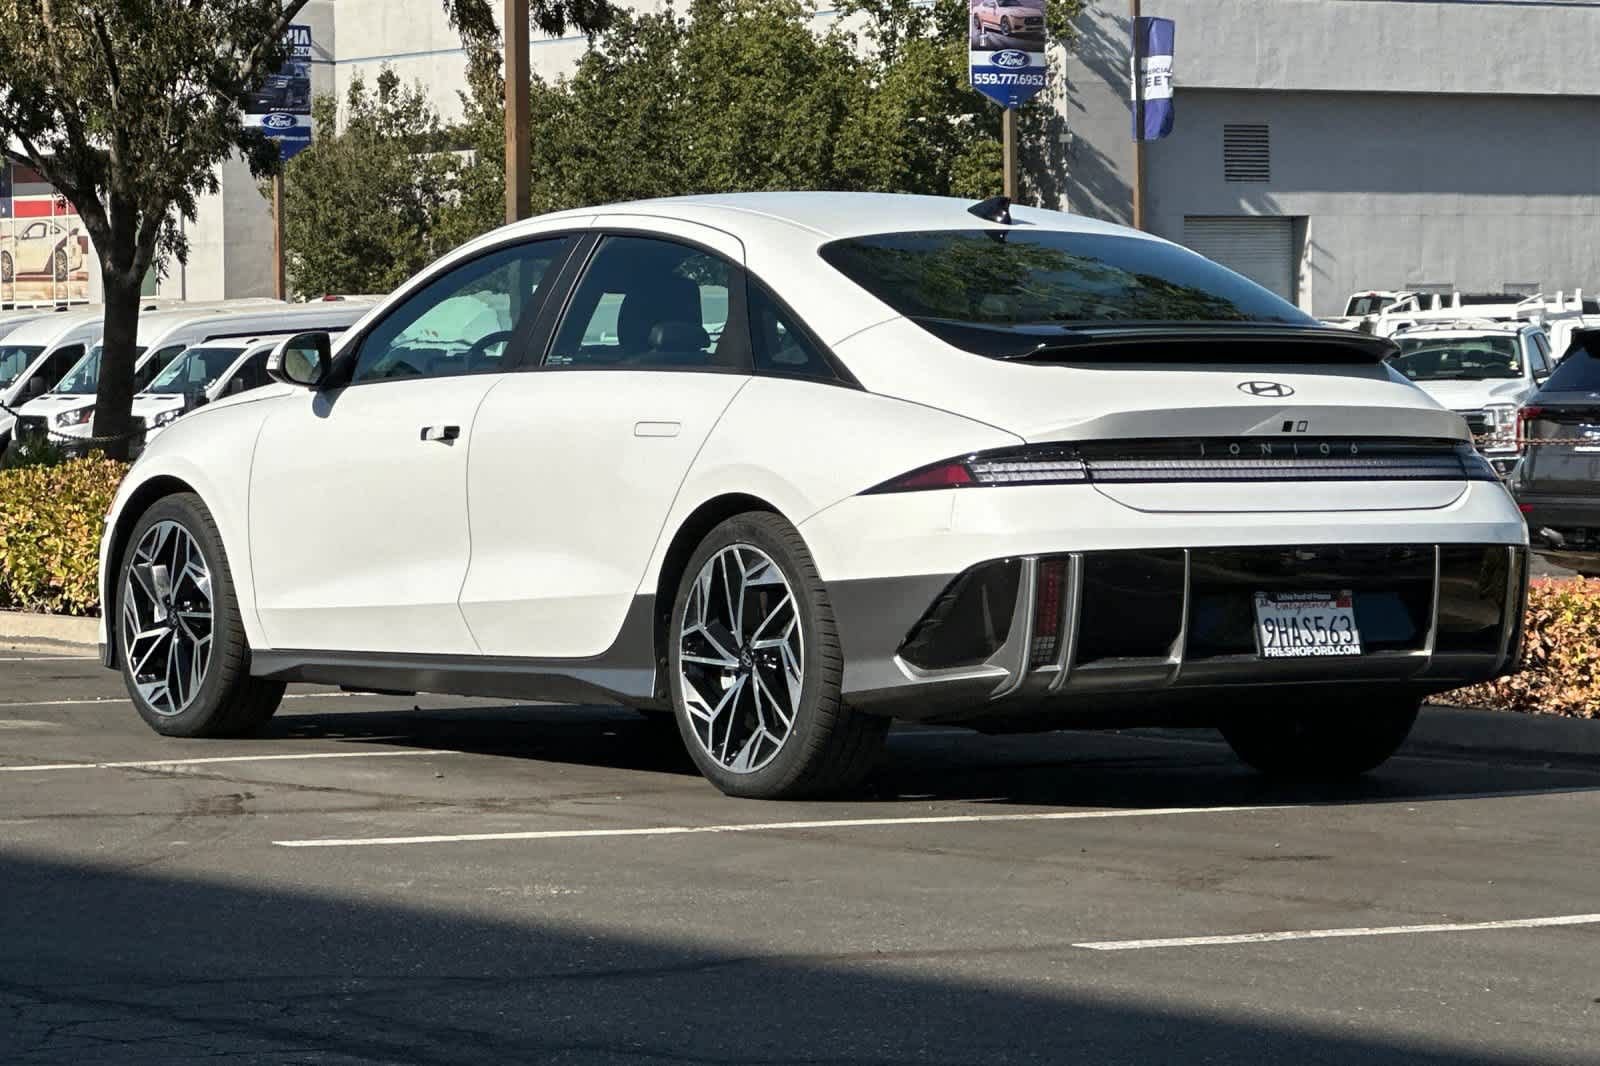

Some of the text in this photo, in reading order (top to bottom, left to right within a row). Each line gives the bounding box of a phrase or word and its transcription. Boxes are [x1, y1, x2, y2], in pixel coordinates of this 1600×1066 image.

[998, 51, 1026, 66] Ford
[973, 73, 1044, 86] 559.777.6952
[267, 114, 293, 128] Ford
[1264, 615, 1353, 648] 9HAS563
[1264, 645, 1361, 658] FRESNOFORD.COM
